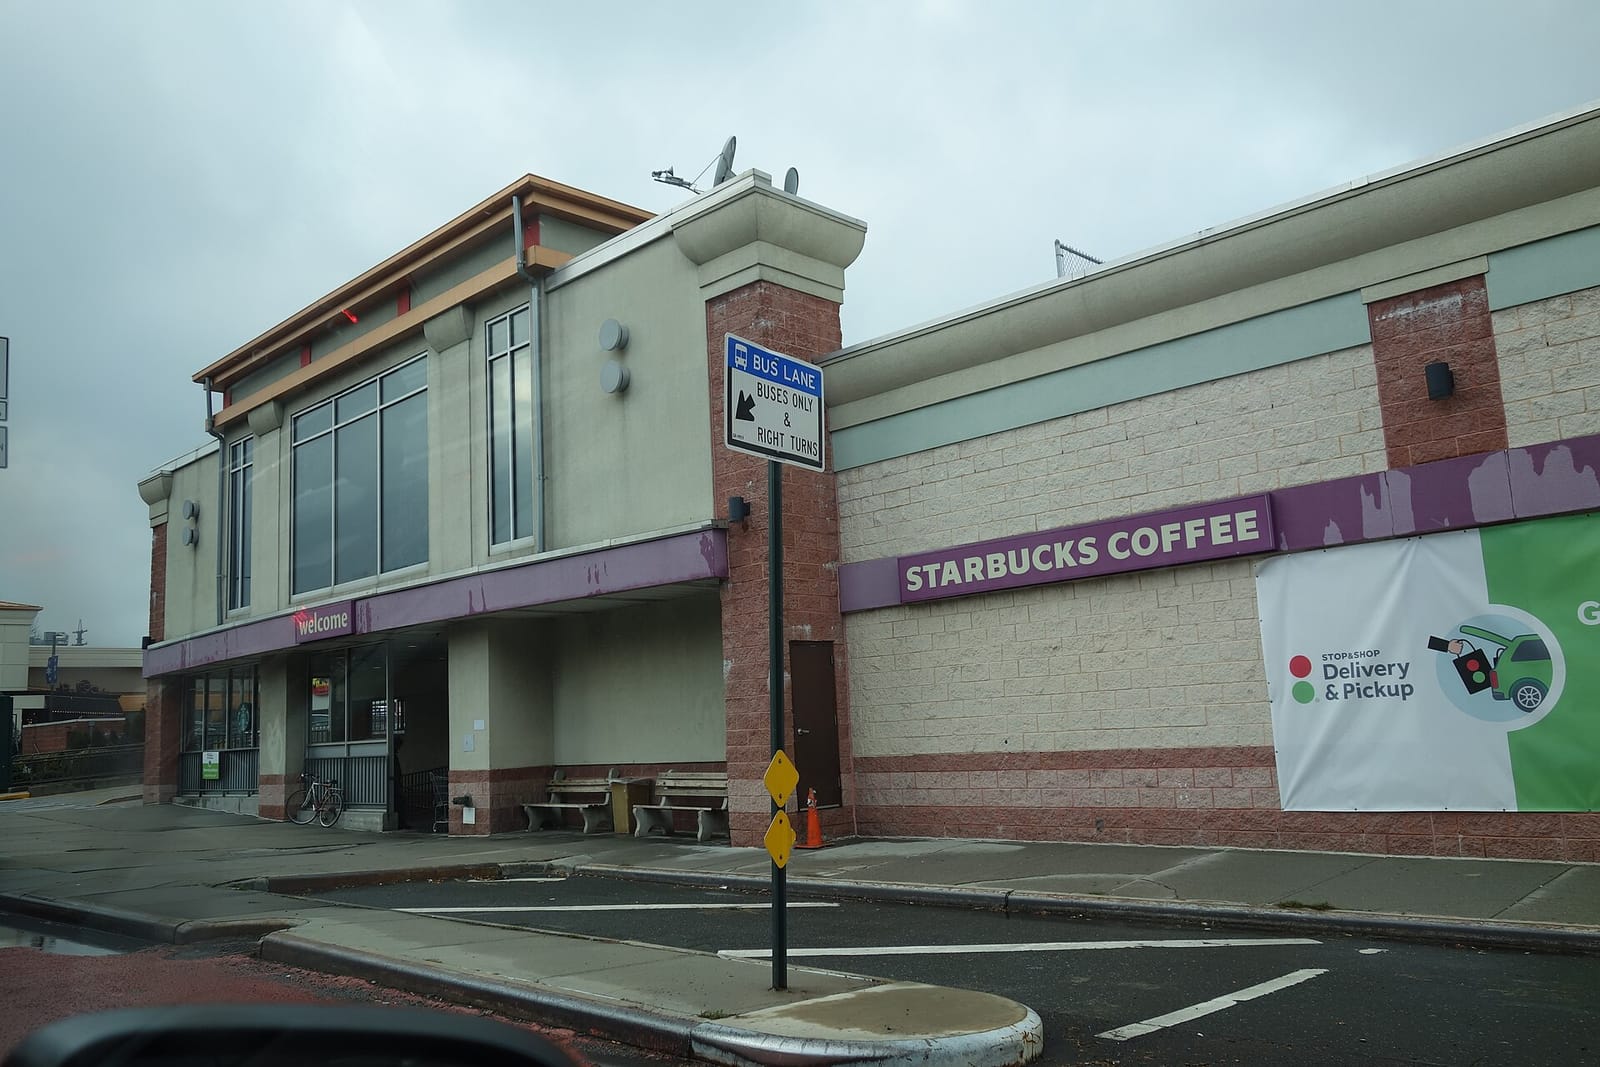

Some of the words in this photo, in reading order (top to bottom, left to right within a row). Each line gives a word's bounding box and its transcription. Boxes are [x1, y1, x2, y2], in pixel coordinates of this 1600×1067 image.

[753, 354, 778, 376] BUS
[783, 365, 816, 390] LANE
[757, 382, 788, 405] BUSES
[792, 393, 813, 413] ONLY
[783, 412, 791, 428] &
[757, 427, 785, 448] RIGHT
[790, 435, 818, 457] TURNS
[906, 536, 1099, 592] STARBUCKS
[1107, 509, 1260, 560] COFFEE
[299, 611, 348, 636] welcome
[1321, 649, 1381, 662] STOP&SHOP
[1322, 661, 1411, 681] Delivery
[1325, 683, 1340, 701] &
[1343, 681, 1415, 701] Pickup
